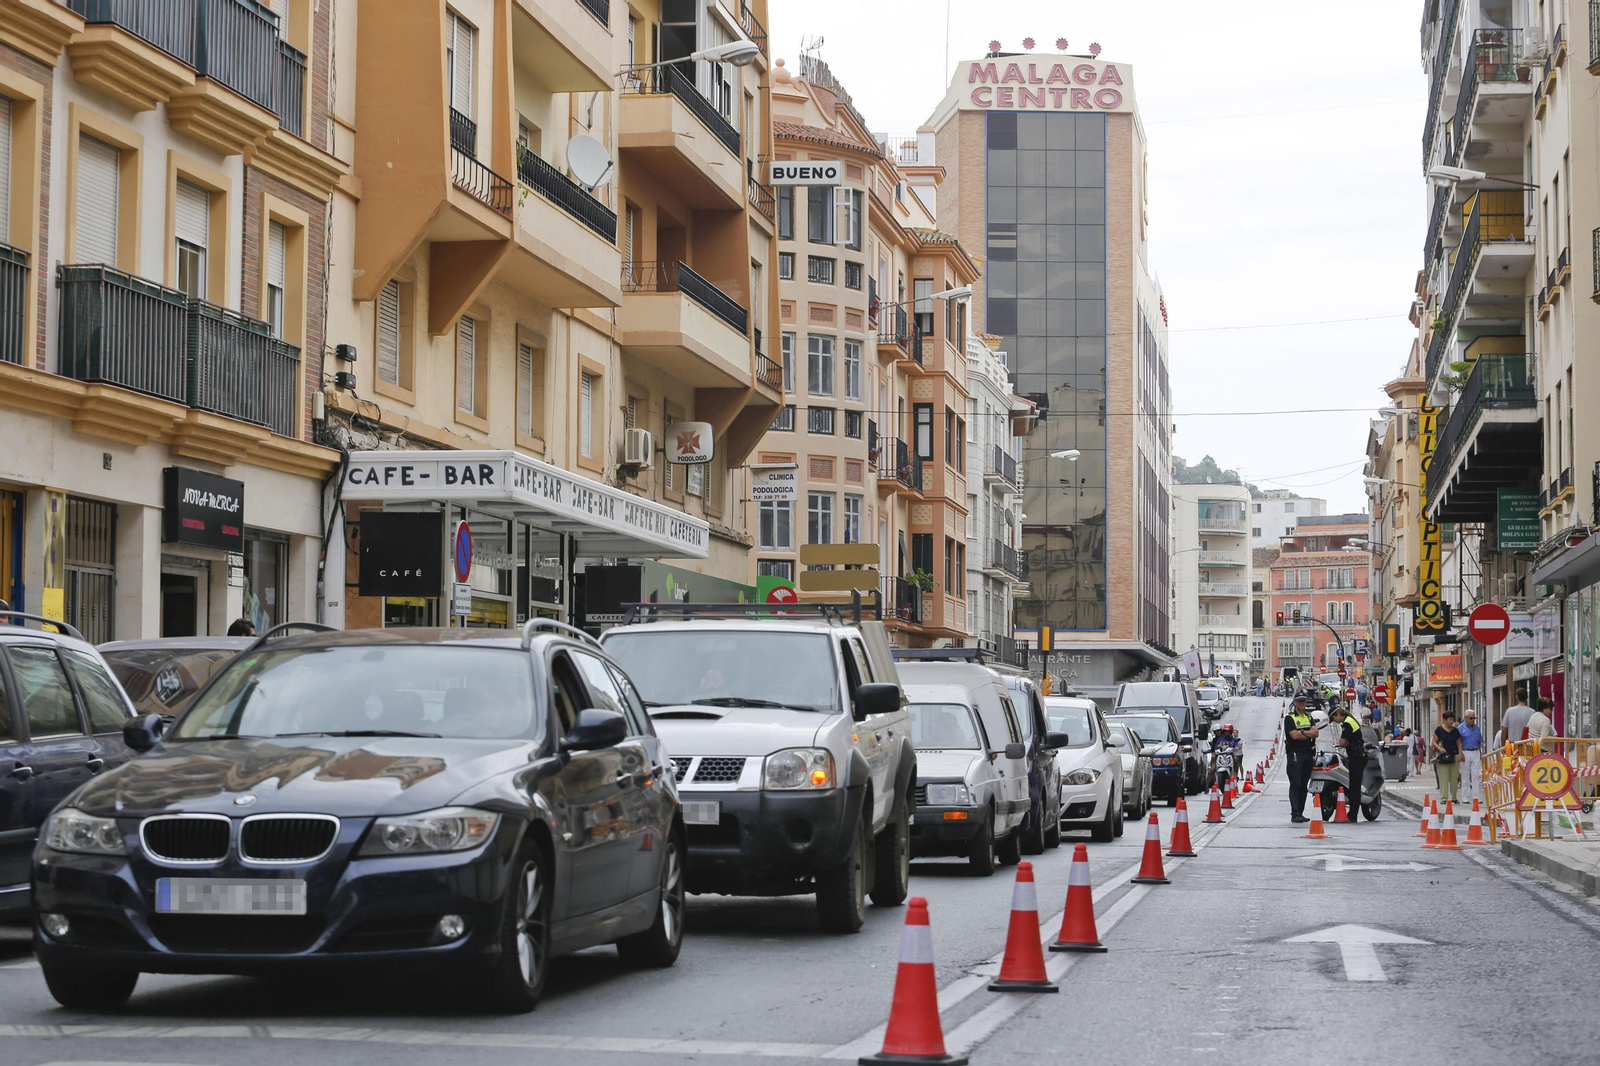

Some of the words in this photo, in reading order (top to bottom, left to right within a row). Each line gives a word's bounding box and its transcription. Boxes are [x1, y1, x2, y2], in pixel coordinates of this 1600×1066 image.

[969, 63, 1123, 85] MALAGA
[971, 86, 1123, 109] CENTRO
[773, 167, 837, 179] BUENO
[445, 464, 494, 485] BAR
[752, 486, 794, 494] PODOLOGICA
[669, 519, 702, 547] CAFETERIA
[380, 568, 422, 577] CAFÉ
[1029, 655, 1092, 664] AURANTE
[1536, 766, 1562, 784] 20
